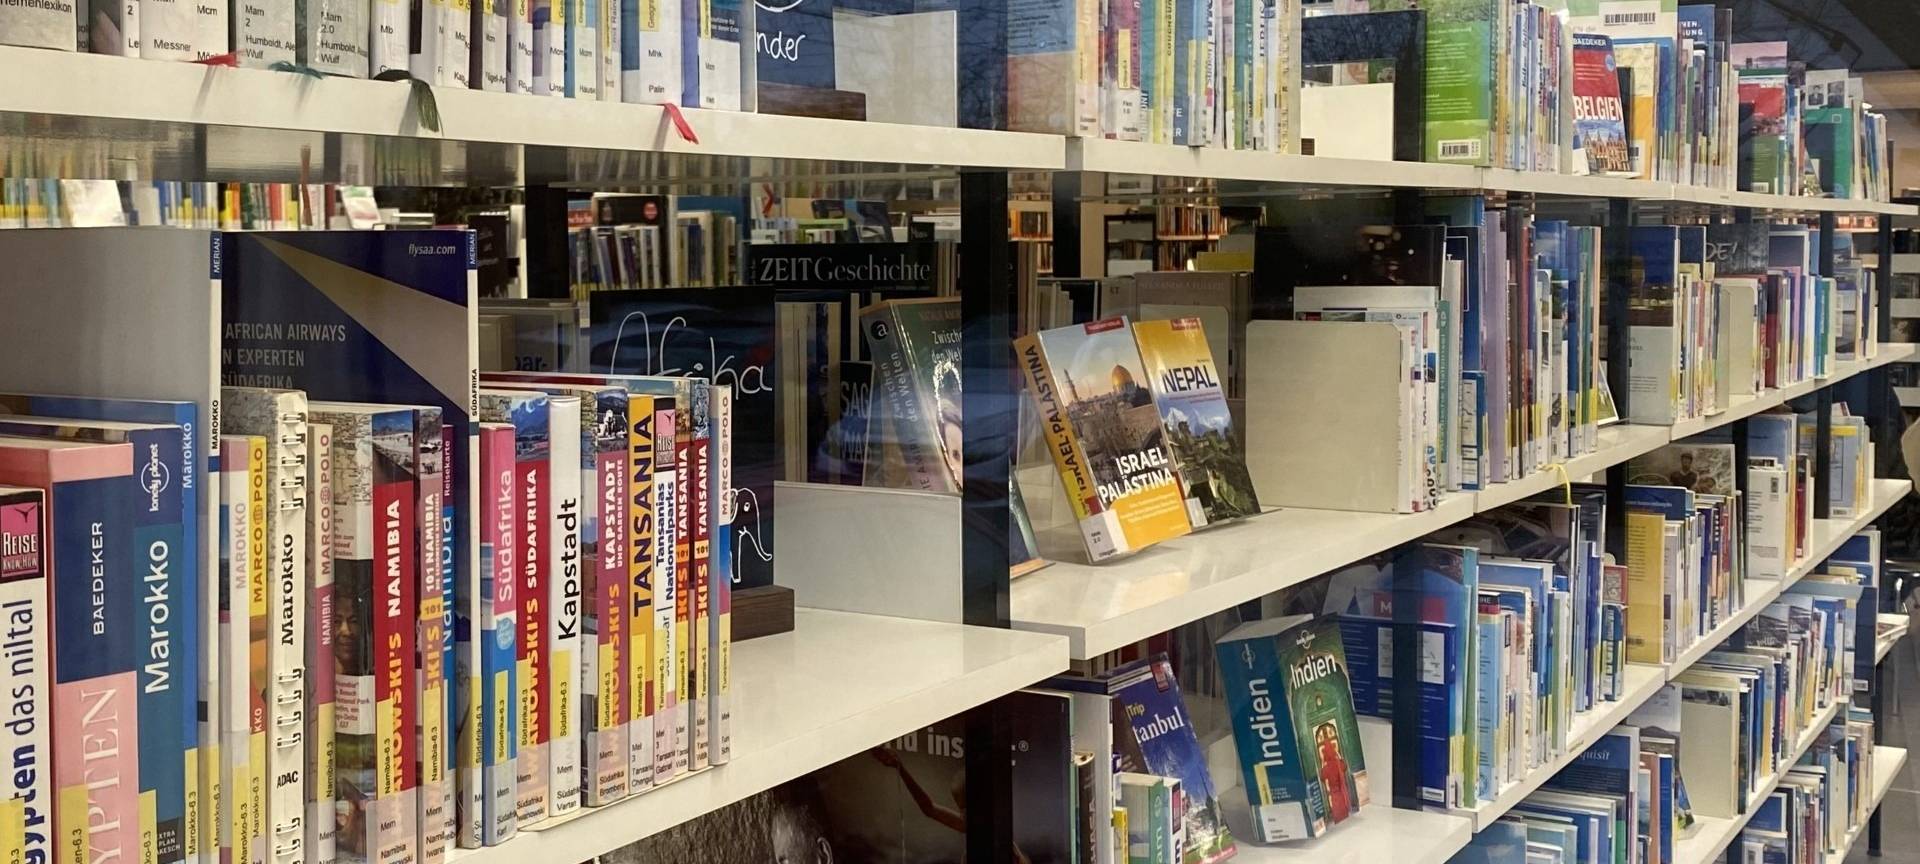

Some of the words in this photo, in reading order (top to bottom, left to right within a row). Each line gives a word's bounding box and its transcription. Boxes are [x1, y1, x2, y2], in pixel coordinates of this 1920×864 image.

[127, 5, 134, 15] 2
[245, 18, 251, 27] 2
[153, 39, 191, 52] Messner
[245, 49, 264, 60] Wulf
[320, 54, 339, 64] Wulf
[1573, 95, 1624, 121] BELGIEN
[213, 237, 221, 273] MERIAN
[408, 243, 457, 256] flysaa.com
[468, 232, 477, 265] MERIAN
[760, 257, 813, 282] ZEIT
[814, 254, 931, 282] Geschichte
[225, 322, 283, 342] AFRICAN
[287, 323, 346, 342] AIRWAYS
[237, 349, 305, 368] EXPERTEN
[1162, 365, 1218, 394] NEPAL
[470, 367, 478, 417] SÜDAFRIKA
[212, 399, 220, 450] MAROKKO
[149, 443, 160, 476] planet
[183, 422, 193, 489] Marokko
[253, 446, 264, 503] POLO
[319, 434, 331, 486] POLO
[444, 440, 452, 498] Reisekarte
[1115, 447, 1169, 477] ISRAEL
[678, 447, 688, 539] TANSANIA
[698, 444, 708, 537] TANSANIA
[1097, 467, 1177, 503] PALÄSTINA
[425, 494, 435, 564] NAMIBIA
[498, 470, 512, 602] Südafrika
[525, 468, 538, 589] SÜDAFRIKA
[605, 460, 617, 570] KAPSTADT
[634, 414, 652, 617] TANSANIA
[655, 482, 665, 567] Tansanias
[3, 532, 38, 556] REISE
[235, 502, 247, 589] MAROKKO
[253, 526, 264, 604] MARCO
[319, 507, 331, 576] MARCO
[387, 499, 401, 618] NAMIBIA
[665, 481, 675, 601] Nationalparks
[91, 521, 105, 636] BAEDEKER
[281, 533, 294, 646] Marokko
[557, 497, 579, 640] Kapstadt
[143, 540, 170, 694] Marokko
[322, 594, 333, 646] NAMIBIA
[425, 603, 441, 615] 101
[3, 599, 35, 677] niltal
[1289, 654, 1337, 689] Indien
[5, 684, 35, 735] das
[1248, 677, 1284, 767] Indien
[276, 770, 299, 790] ADAC
[380, 820, 397, 832] Mem
[425, 805, 443, 817] Mem
